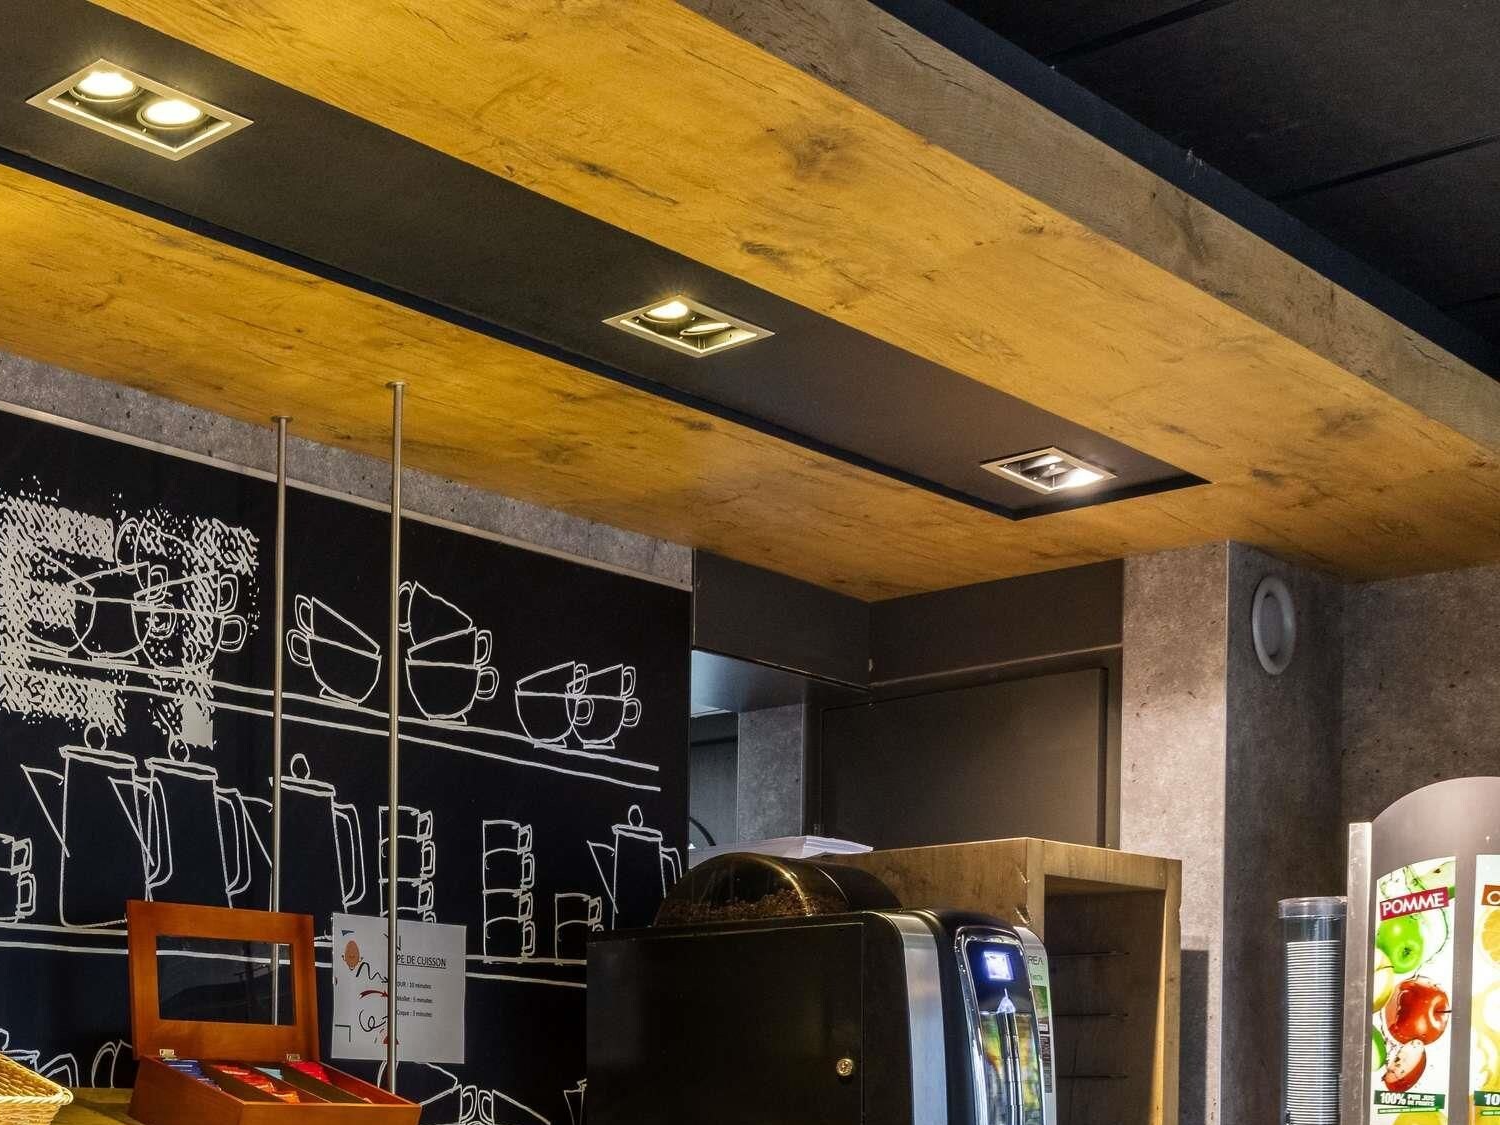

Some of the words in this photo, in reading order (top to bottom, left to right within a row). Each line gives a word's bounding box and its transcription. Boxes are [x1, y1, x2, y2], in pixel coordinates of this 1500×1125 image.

[1381, 892, 1445, 917] POMME
[407, 955, 415, 965] DE
[417, 956, 446, 967] CUISSON
[1380, 1091, 1406, 1105] 100%
[1484, 1093, 1500, 1106] 10
